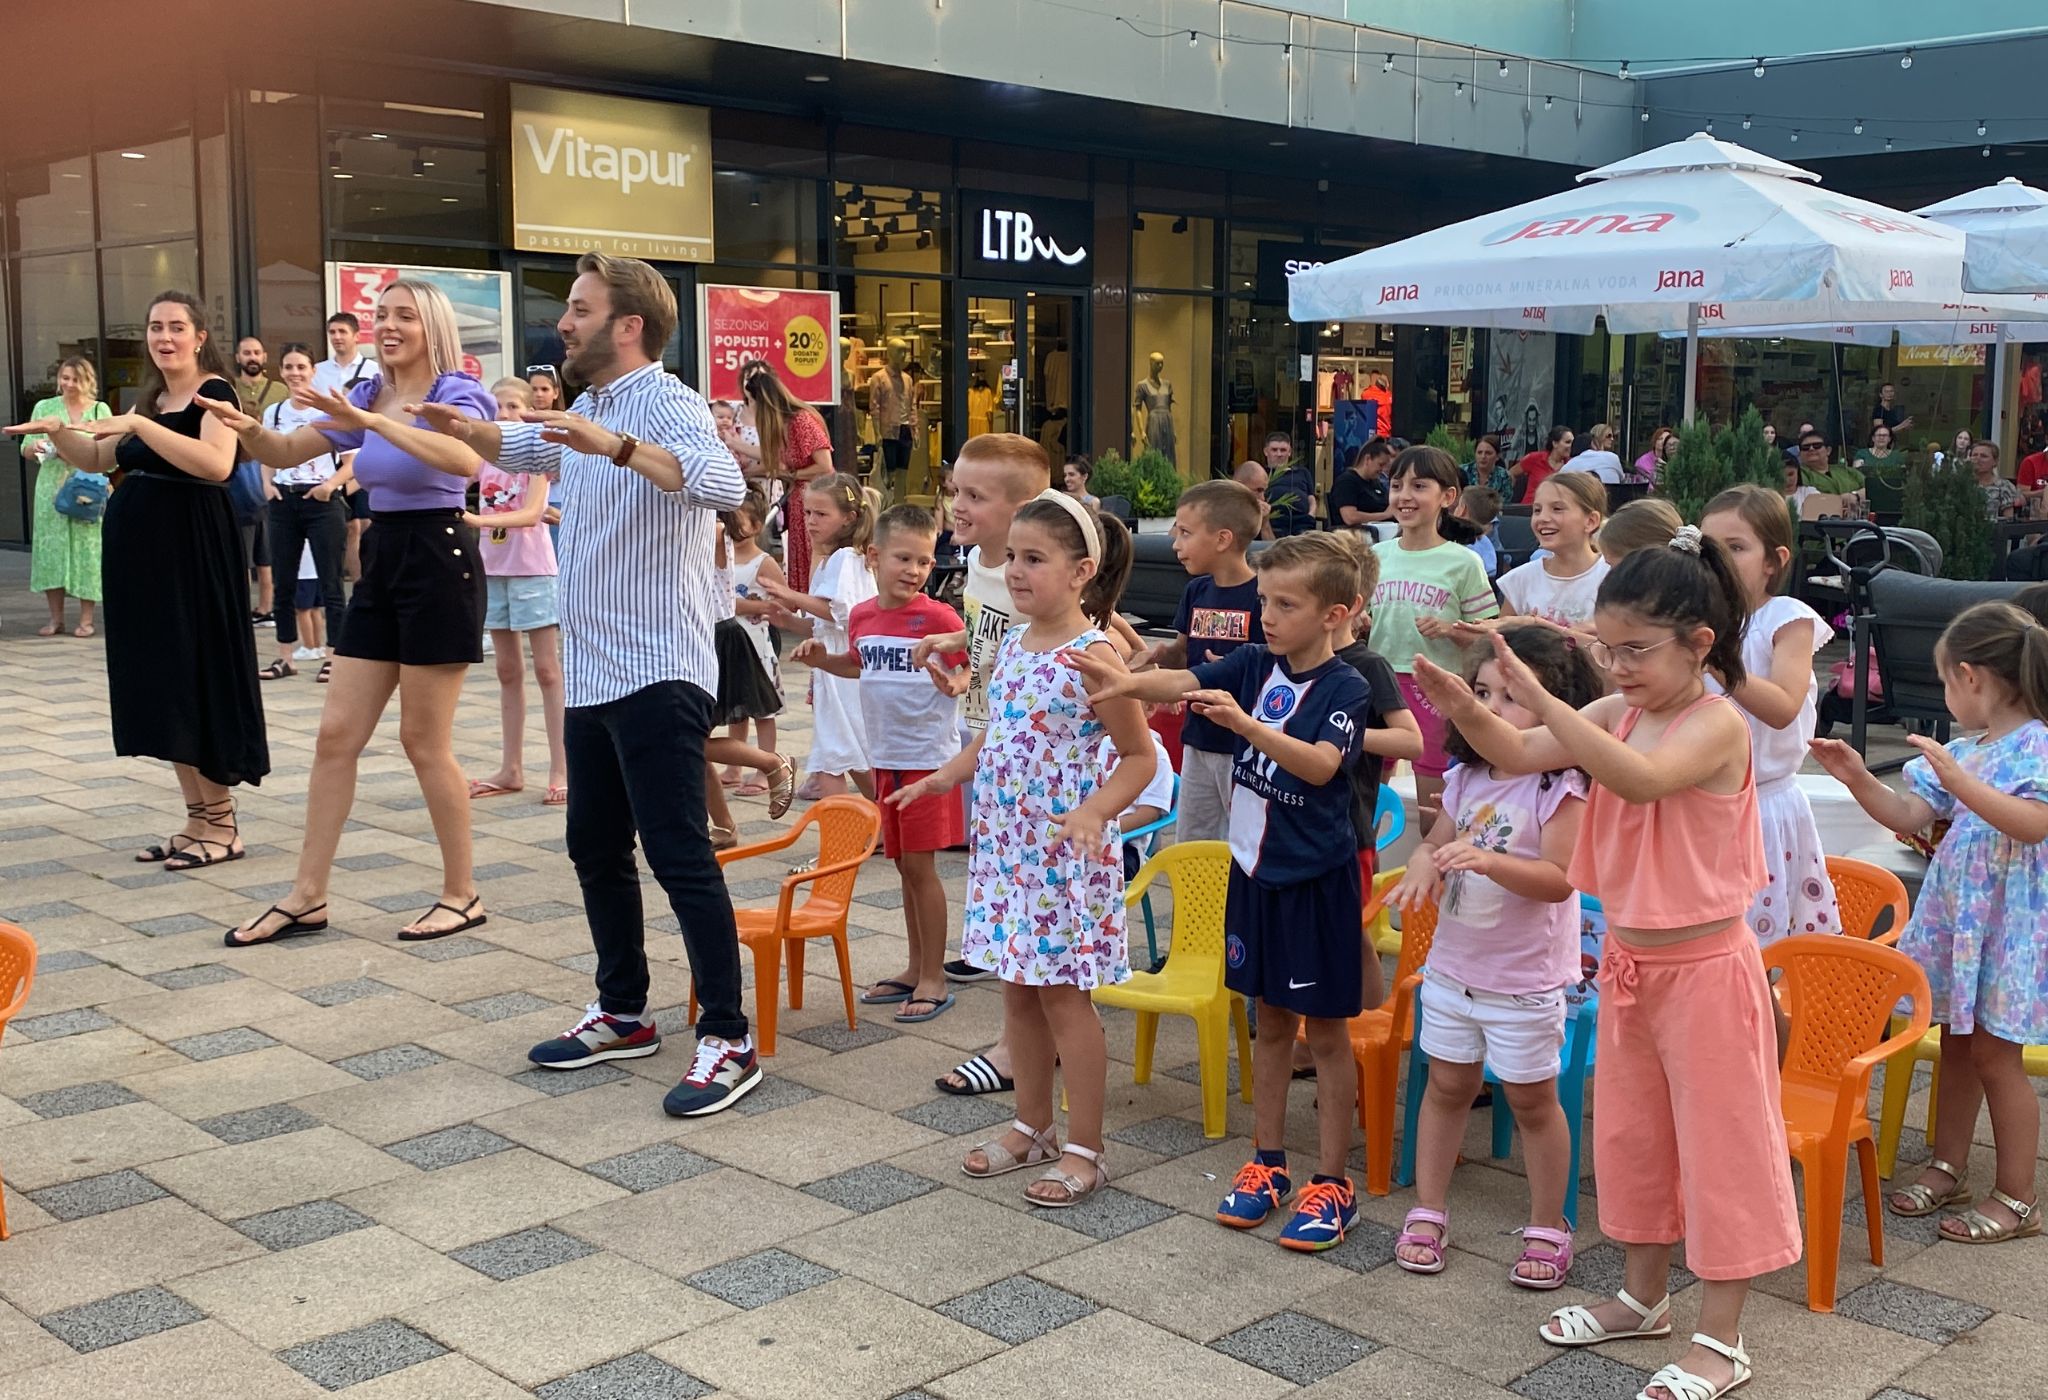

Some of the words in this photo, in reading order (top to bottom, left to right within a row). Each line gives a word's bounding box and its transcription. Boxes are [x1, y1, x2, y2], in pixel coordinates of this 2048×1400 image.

[522, 124, 691, 194] Vitapur
[982, 208, 1034, 261] LTB
[529, 234, 602, 250] passion
[613, 239, 638, 252] for
[649, 241, 698, 258] living
[1433, 282, 1503, 297] PRIRODNA
[1508, 277, 1591, 294] MINERALNA
[1598, 275, 1638, 289] VODA
[713, 319, 769, 331] SEZONSKI
[714, 335, 769, 348] POPUSTI
[789, 331, 823, 350] 20%
